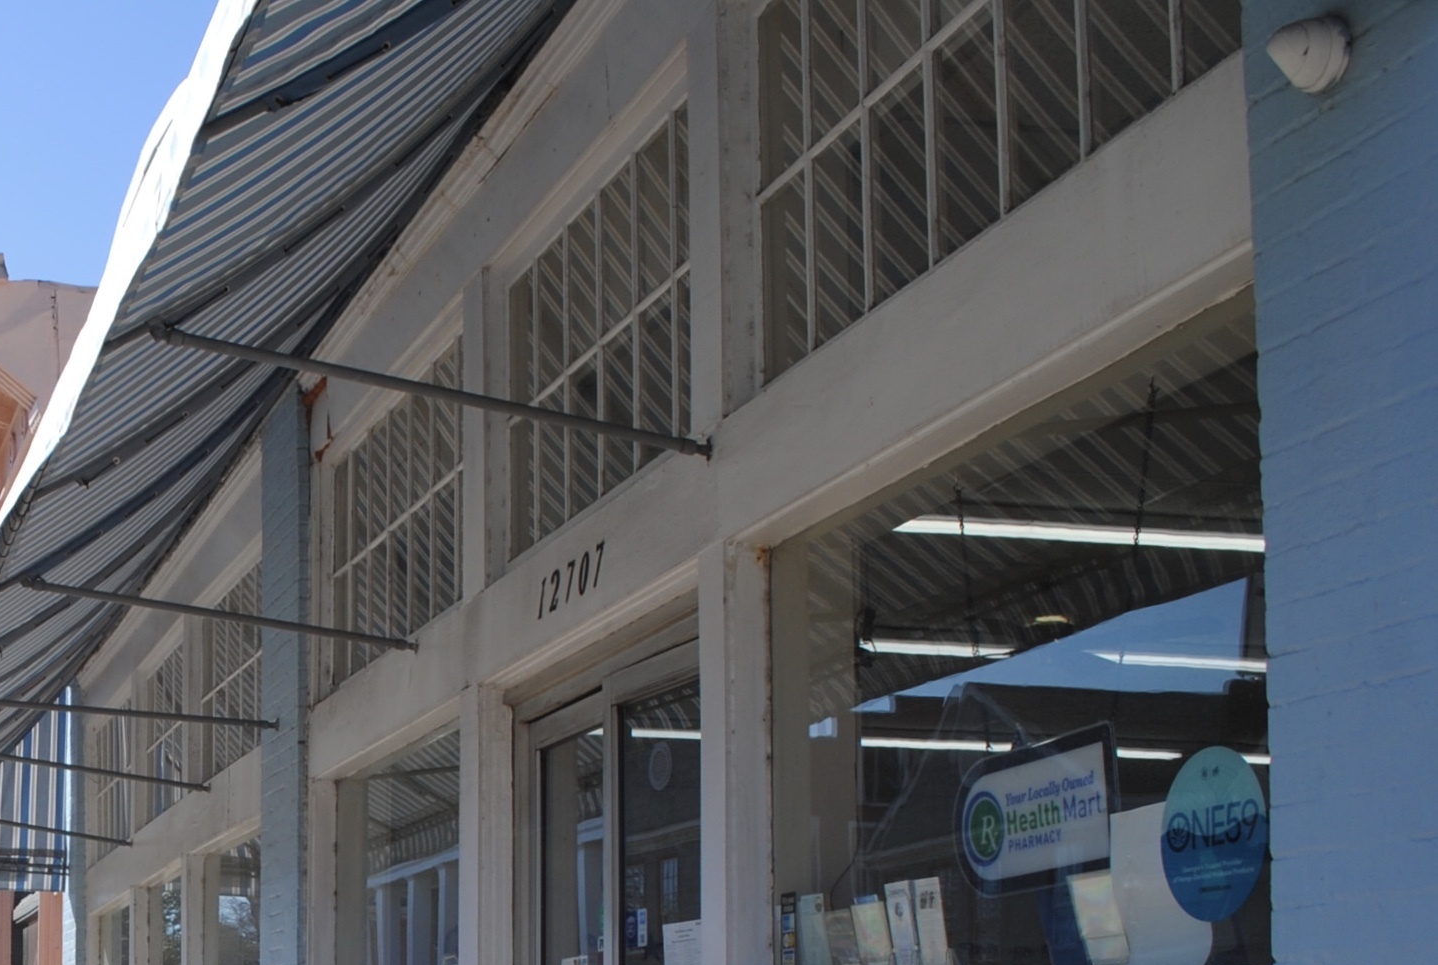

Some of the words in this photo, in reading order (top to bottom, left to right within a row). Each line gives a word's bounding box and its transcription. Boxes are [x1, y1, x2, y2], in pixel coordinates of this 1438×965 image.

[538, 540, 605, 620] 12707
[1005, 791, 1027, 807] Your
[1028, 781, 1061, 801] Locally
[1062, 770, 1094, 792] Owned
[1008, 828, 1062, 853] PHARMACY
[1167, 798, 1260, 853] ONE59
